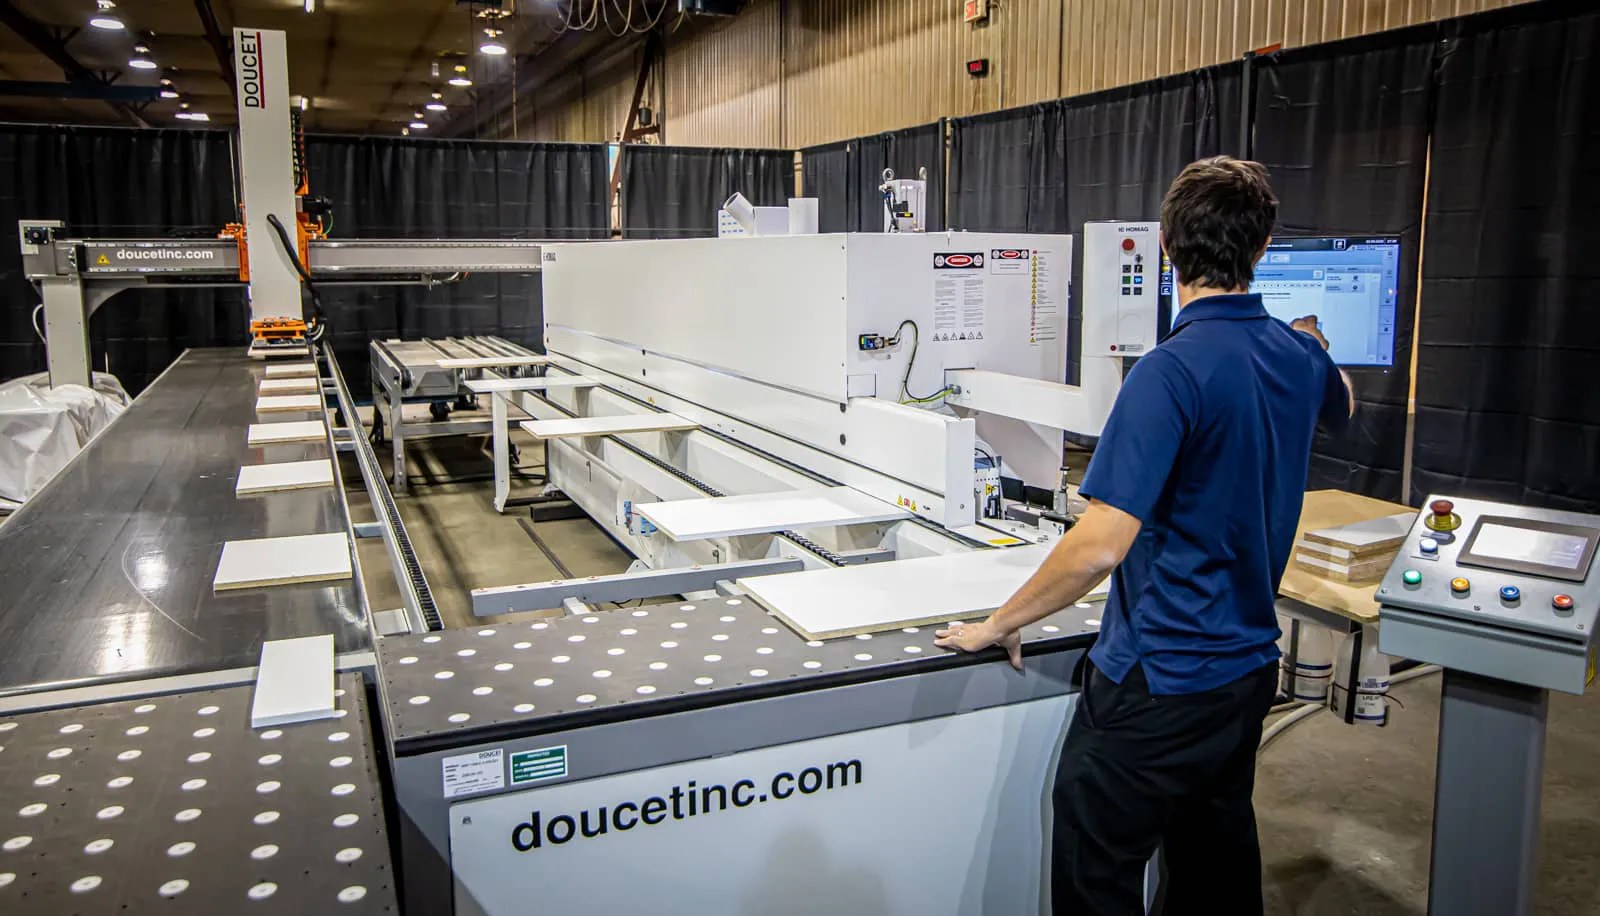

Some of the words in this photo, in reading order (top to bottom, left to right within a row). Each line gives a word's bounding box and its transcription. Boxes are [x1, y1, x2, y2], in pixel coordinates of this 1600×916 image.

[240, 31, 260, 107] DOUCET
[116, 248, 214, 259] doucetinc.com
[511, 758, 863, 852] doucetinc.com
